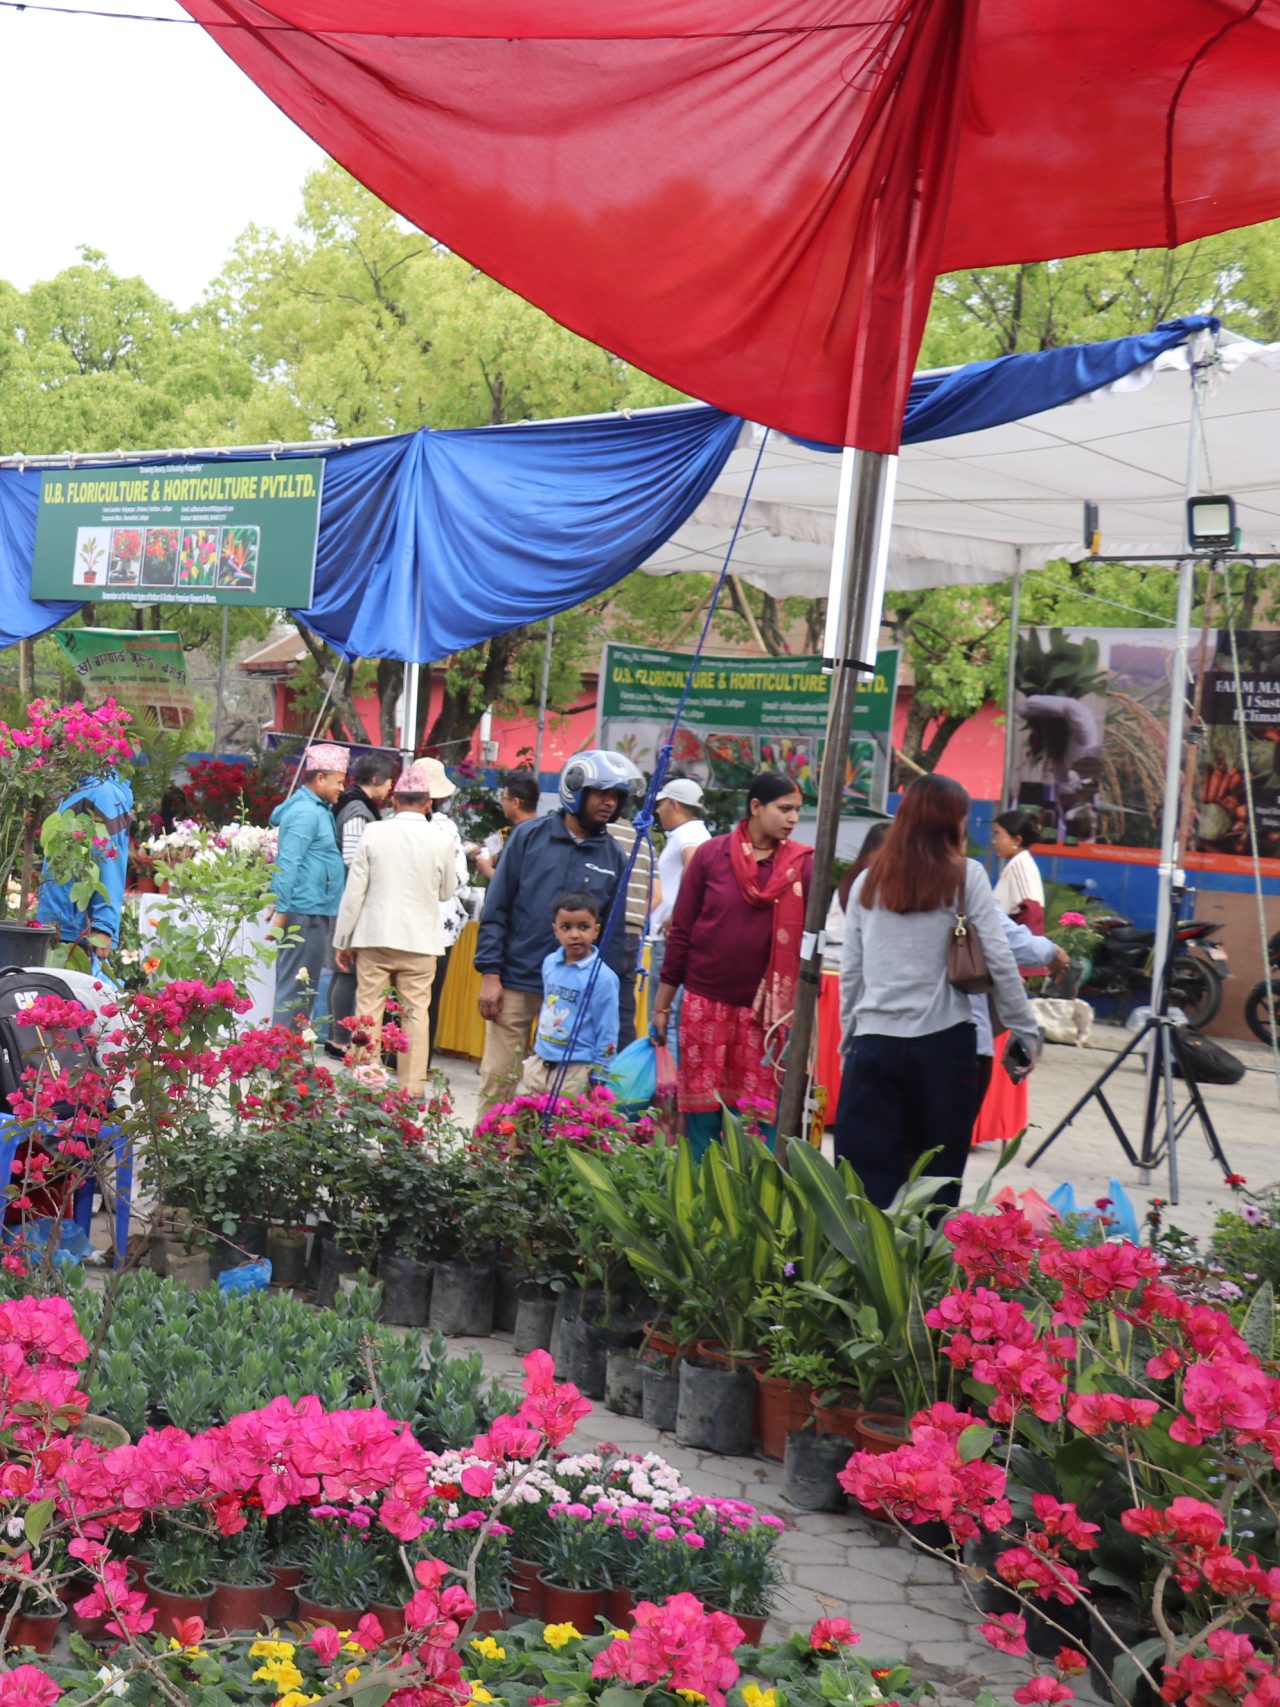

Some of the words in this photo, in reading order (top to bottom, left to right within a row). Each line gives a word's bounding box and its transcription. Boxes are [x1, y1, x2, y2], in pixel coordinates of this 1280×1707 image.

[67, 480, 150, 503] FLORICULTURE
[151, 479, 160, 501] &
[163, 476, 258, 501] HORTICULTURE
[260, 474, 316, 499] PVT.LTD.
[717, 672, 727, 690] &
[729, 672, 827, 693] HORTICULTURE
